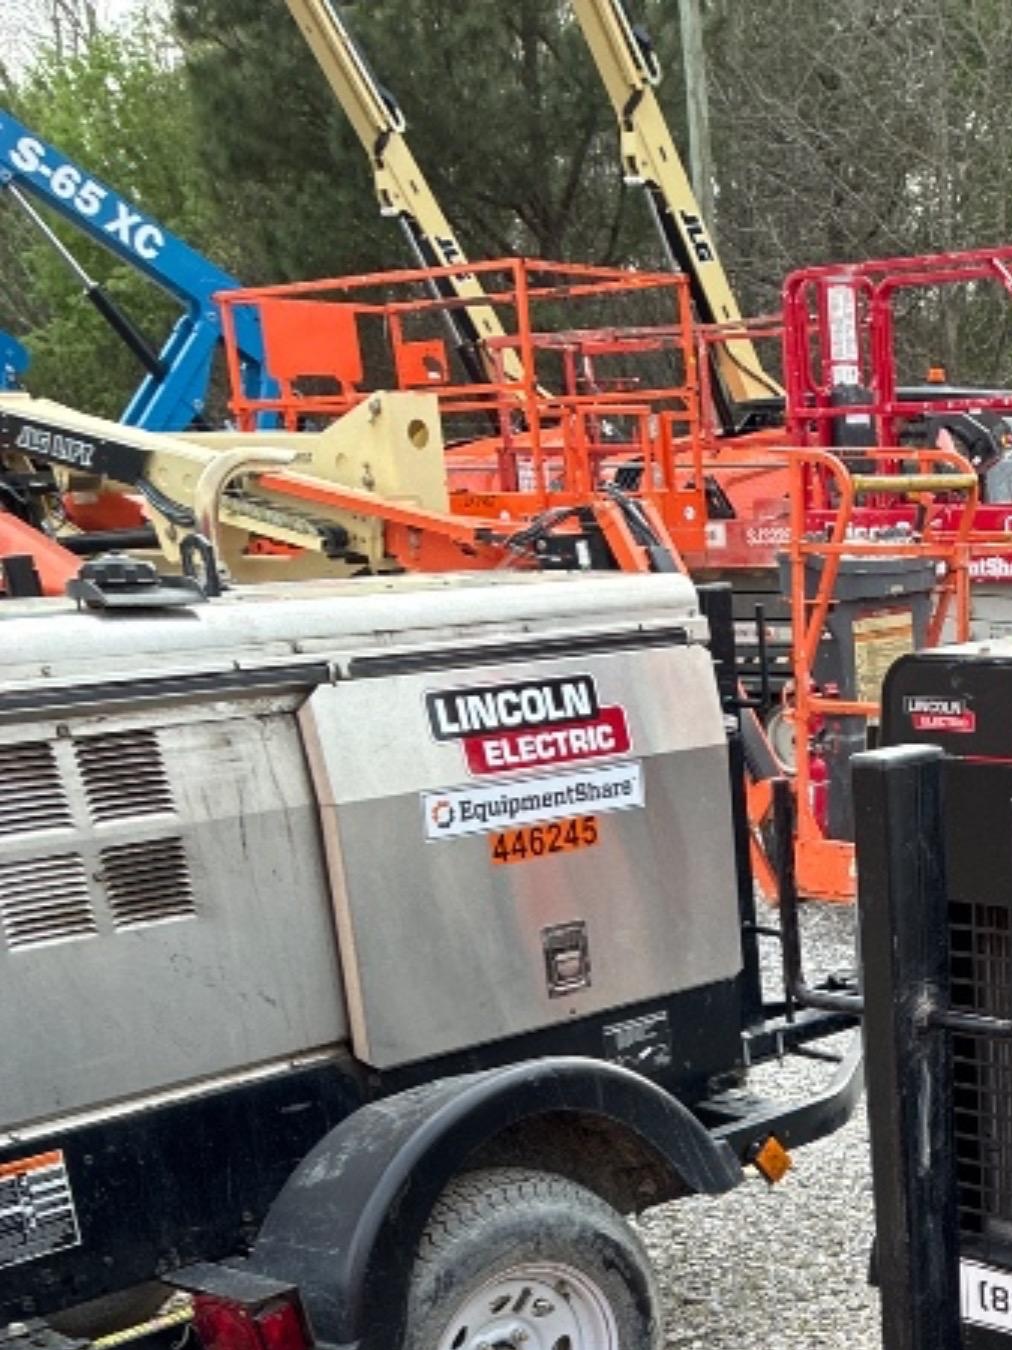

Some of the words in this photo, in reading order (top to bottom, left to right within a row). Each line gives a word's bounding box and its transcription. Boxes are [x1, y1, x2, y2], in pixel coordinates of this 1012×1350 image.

[9, 137, 108, 216] S-65
[104, 201, 165, 259] XC
[679, 209, 714, 262] JLG
[434, 681, 592, 733] LINCOLN
[482, 725, 615, 767] ELECTRIC
[459, 778, 632, 821] EquipmentShare
[493, 816, 598, 862] 446245
